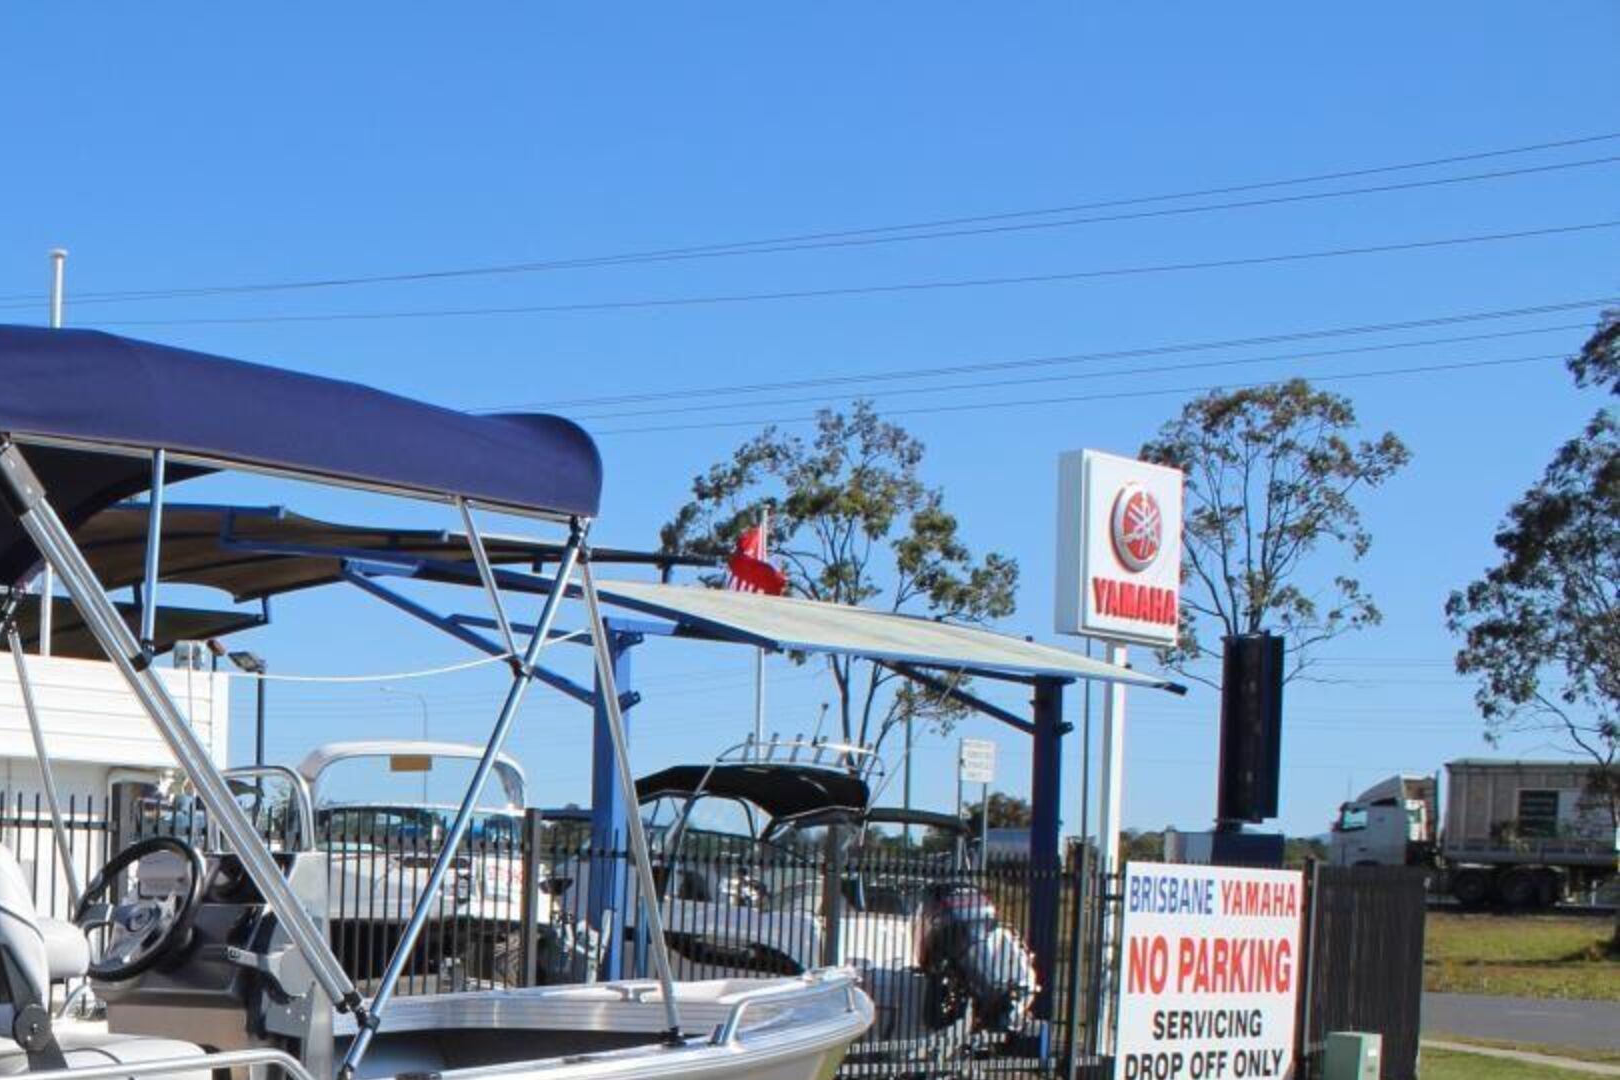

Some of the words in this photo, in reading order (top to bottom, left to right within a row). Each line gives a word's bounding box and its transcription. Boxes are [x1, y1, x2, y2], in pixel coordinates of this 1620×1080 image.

[1092, 577, 1177, 626] YAMAHA
[1130, 875, 1214, 915] BRISBANE
[1221, 879, 1296, 917] YAMAHA
[1128, 935, 1169, 995] NO
[1177, 937, 1292, 994] PARKING
[1152, 1008, 1262, 1041] SERVICING
[1189, 1051, 1228, 1079] OFF
[1233, 1049, 1283, 1077] ONLY
